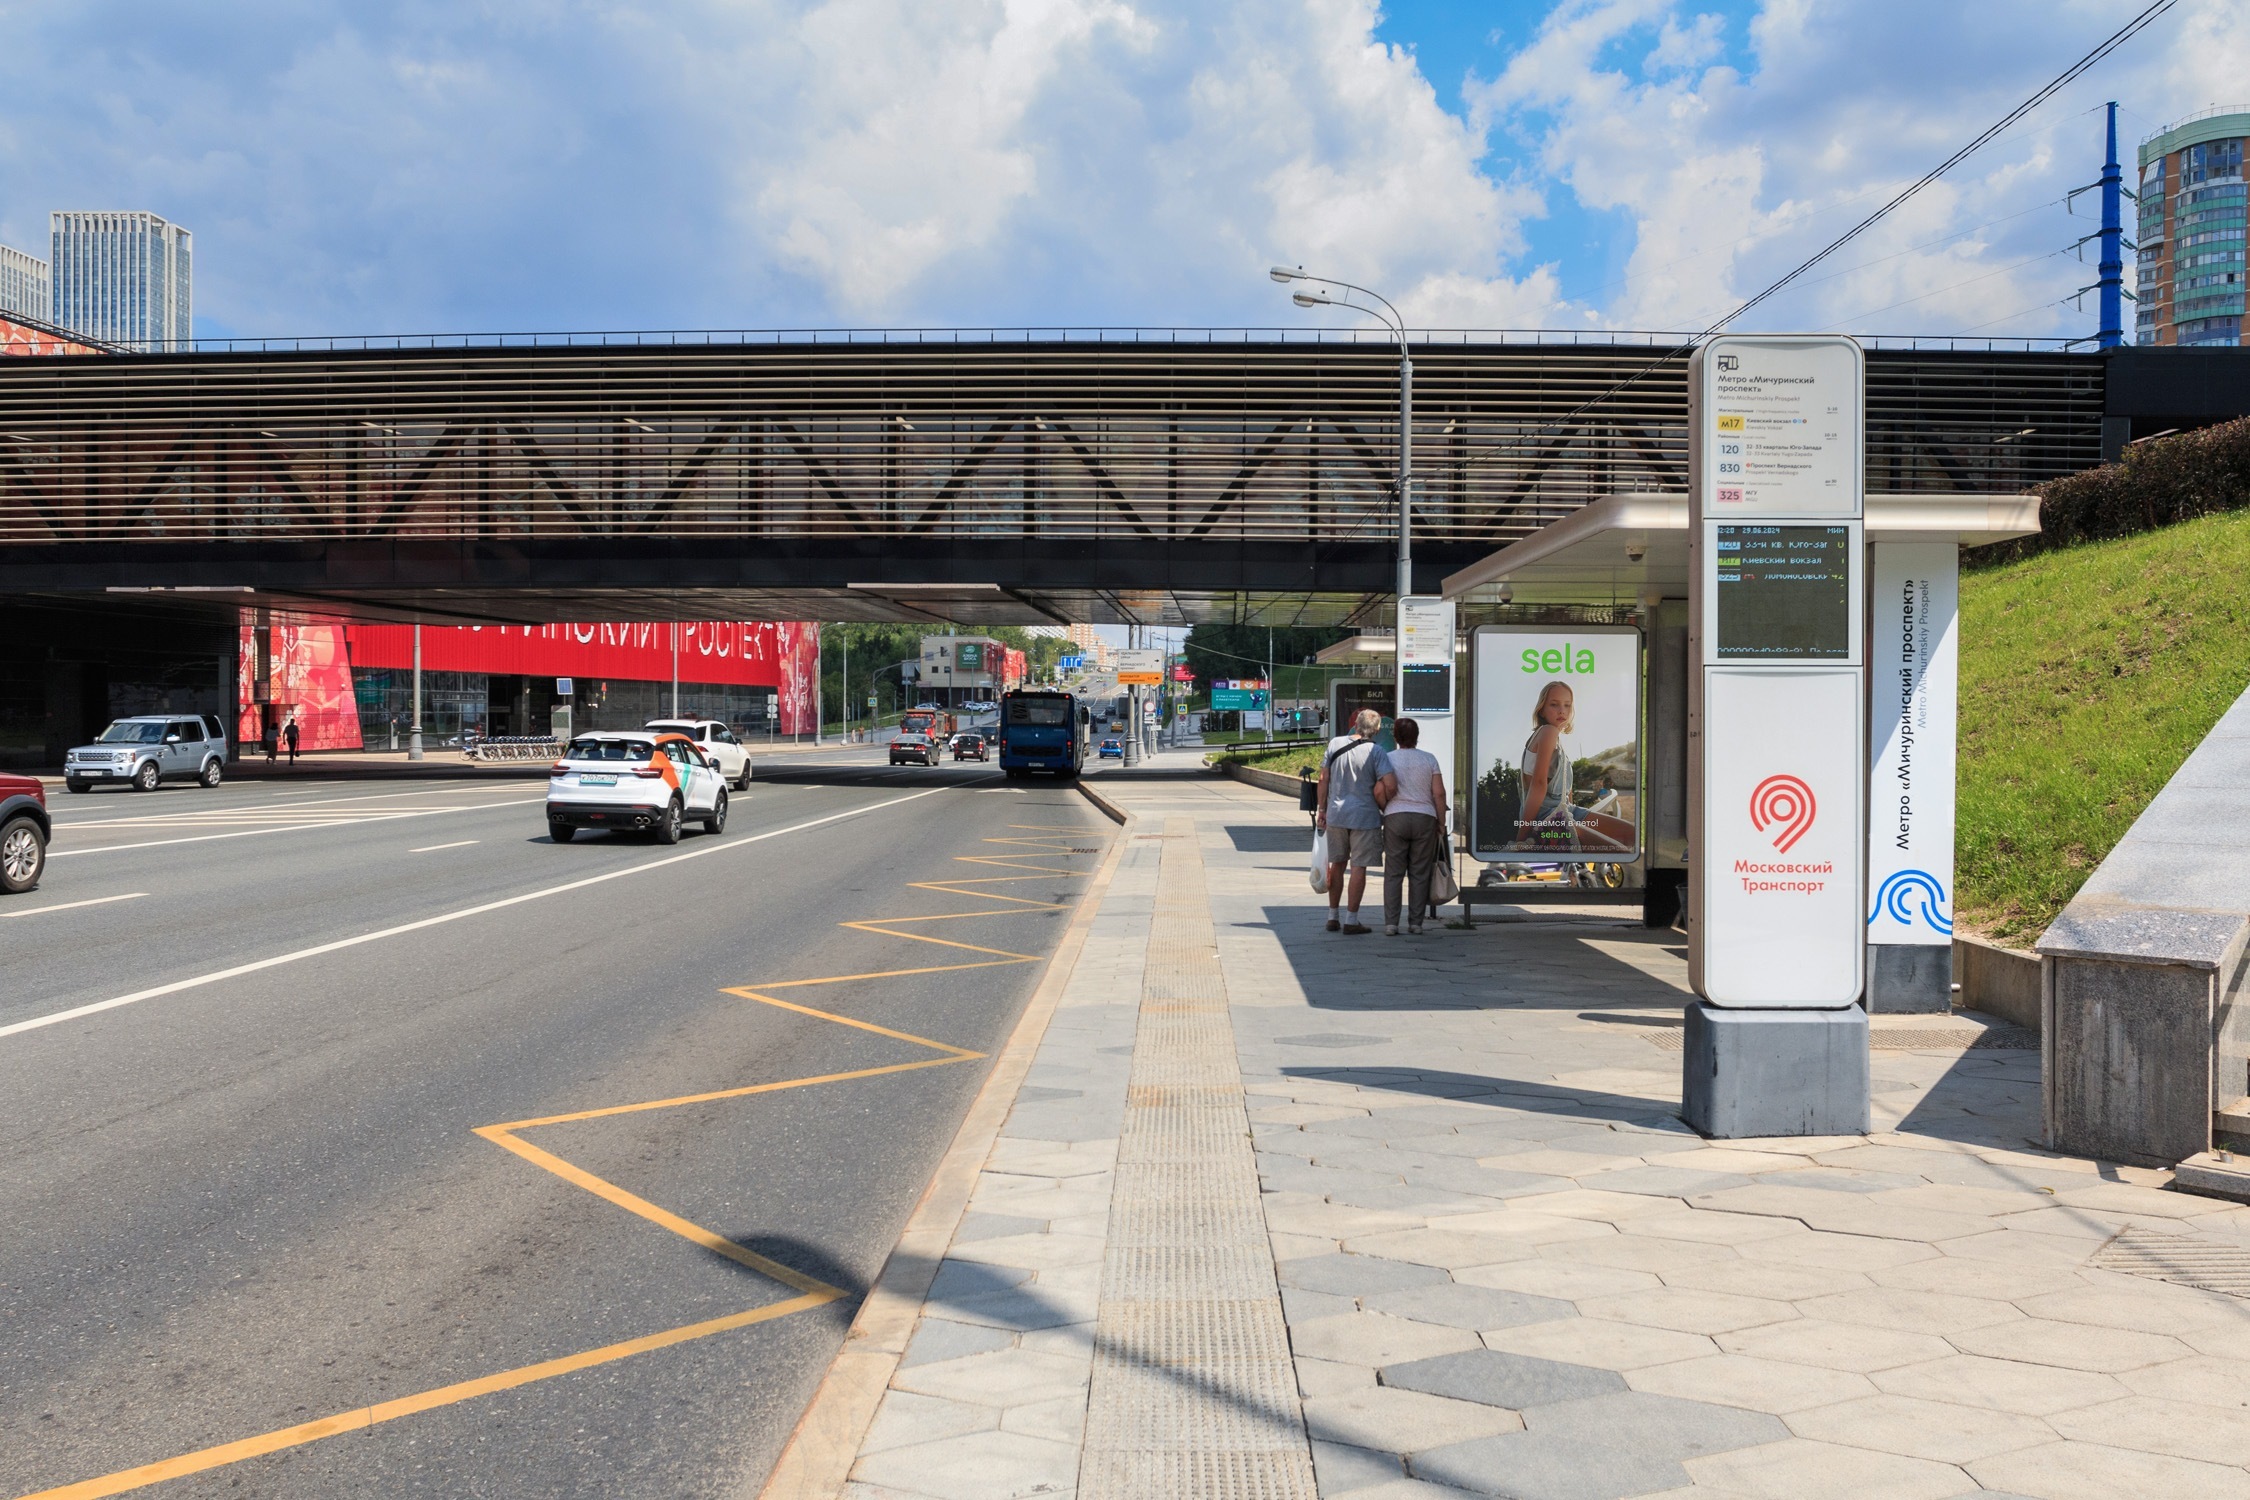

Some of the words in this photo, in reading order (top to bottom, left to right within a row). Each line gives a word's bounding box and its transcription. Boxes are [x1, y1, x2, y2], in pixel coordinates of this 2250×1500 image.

[1717, 375, 1747, 384] Метро
[1749, 376, 1815, 385] «Мичуринский
[1717, 385, 1762, 393] проспект»
[1721, 445, 1739, 454] 120
[1720, 463, 1740, 473] 830
[1720, 490, 1740, 500] 325
[1918, 579, 1931, 625] Prospekt
[1901, 579, 1916, 664] проспект»
[1521, 643, 1595, 674] sela
[1917, 626, 1931, 694] Michurinskiy
[1367, 690, 1384, 698] БКЛ
[1917, 696, 1928, 728] Metro
[1898, 669, 1915, 791] «Мичуринский
[1513, 820, 1566, 829] врываемся
[1575, 818, 1599, 828] лето!
[1896, 794, 1913, 850] Метро
[1540, 831, 1572, 839] sela.ru
[1734, 860, 1833, 873] Московский
[1741, 878, 1825, 895] Транспорт
